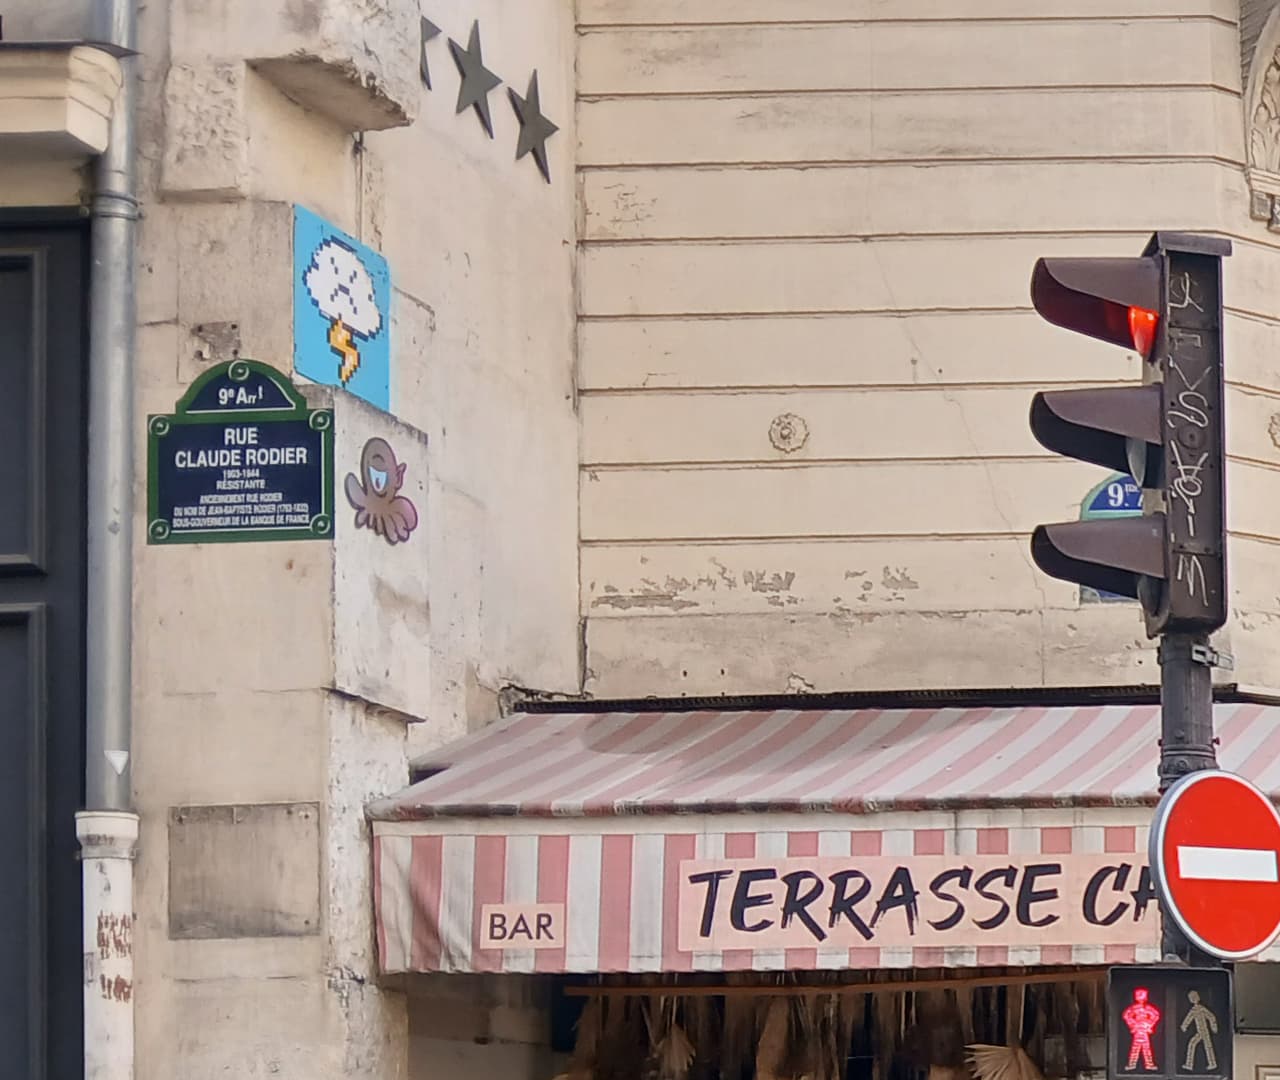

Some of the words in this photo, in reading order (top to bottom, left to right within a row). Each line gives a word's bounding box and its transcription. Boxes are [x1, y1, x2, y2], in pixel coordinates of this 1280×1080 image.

[224, 427, 258, 445] RUE
[175, 450, 241, 468] CLAUDE
[246, 447, 308, 465] RODIER
[688, 866, 1063, 943] TERRASSE
[488, 913, 554, 941] BAR
